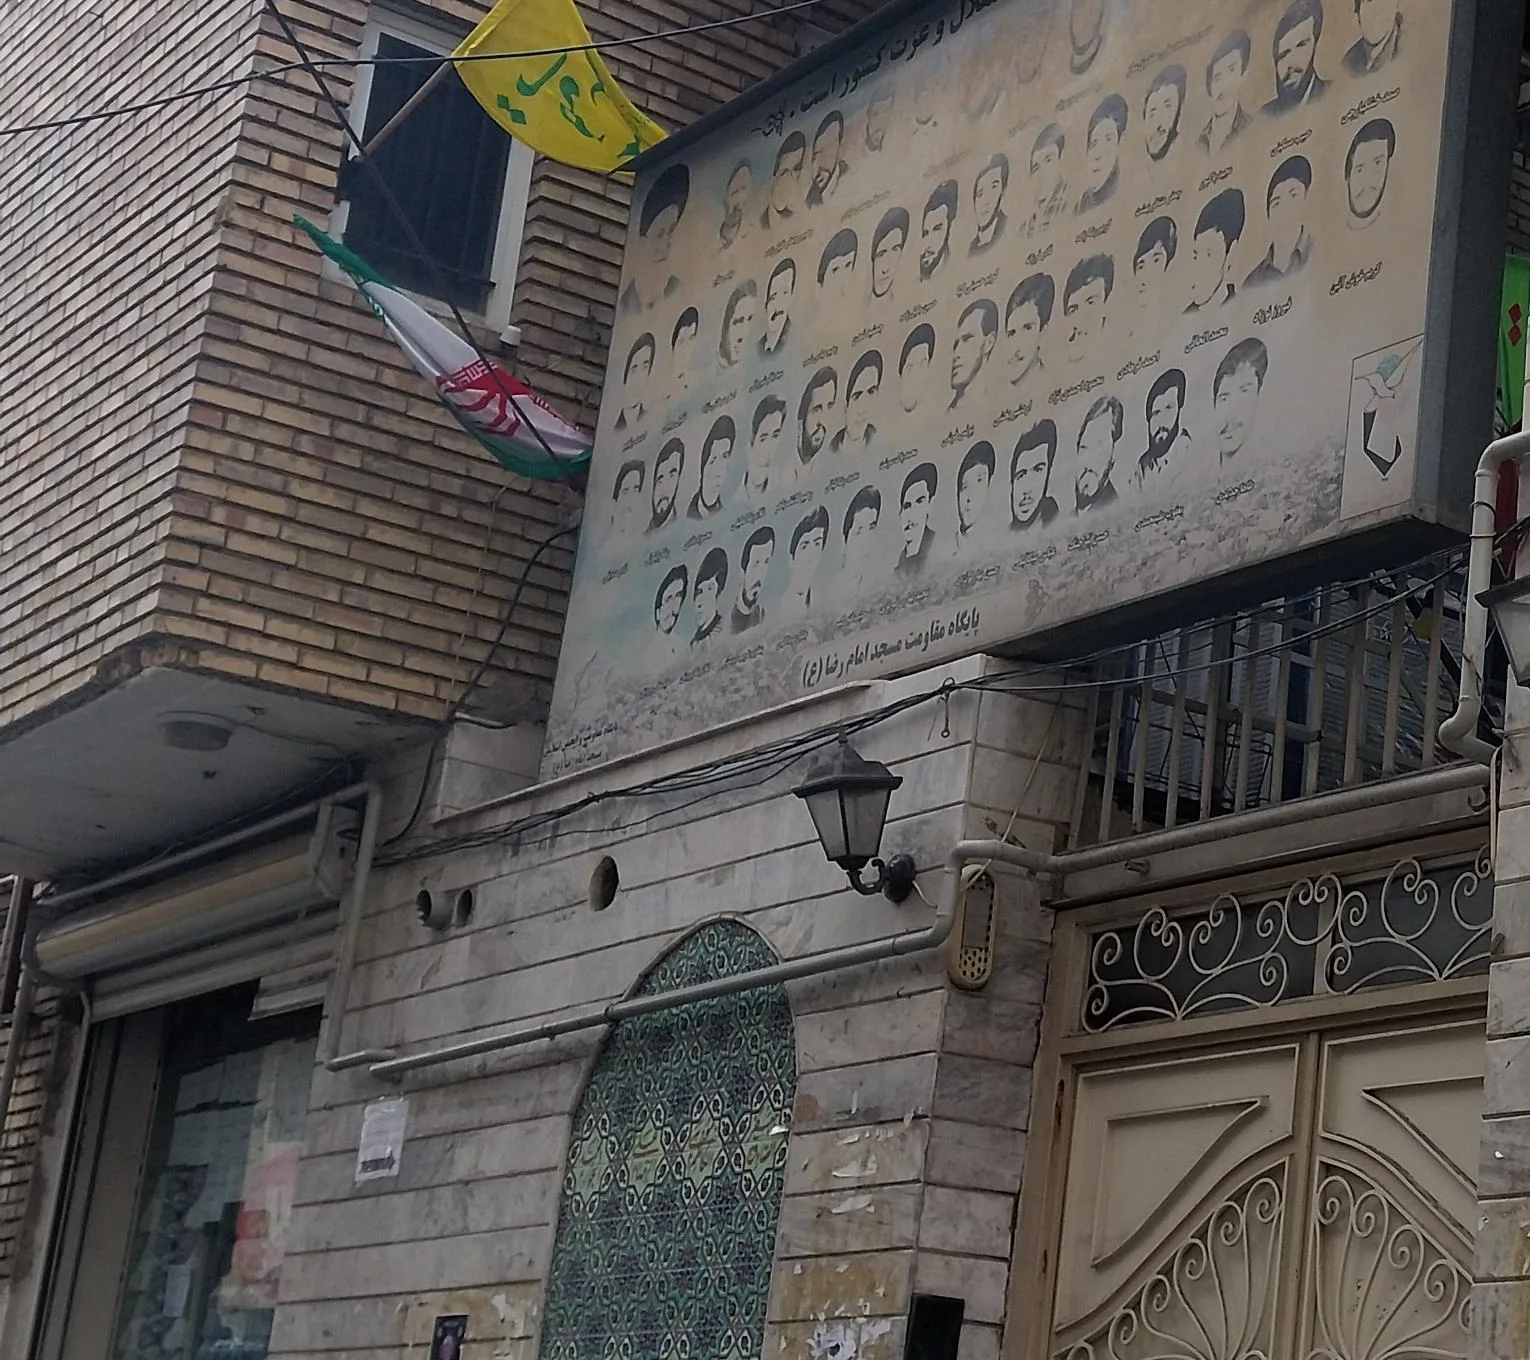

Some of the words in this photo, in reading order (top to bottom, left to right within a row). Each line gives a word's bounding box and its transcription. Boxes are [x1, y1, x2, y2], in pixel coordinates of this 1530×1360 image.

[889, 26, 931, 63] عزت
[934, 21, 945, 45] و
[839, 50, 885, 99] کشور
[904, 619, 945, 653] مقاومت
[947, 606, 980, 637] پایگاه
[825, 652, 844, 680] رضا
[846, 641, 869, 673] امام
[869, 639, 902, 665] مسجد
[802, 656, 823, 688] (ع)
